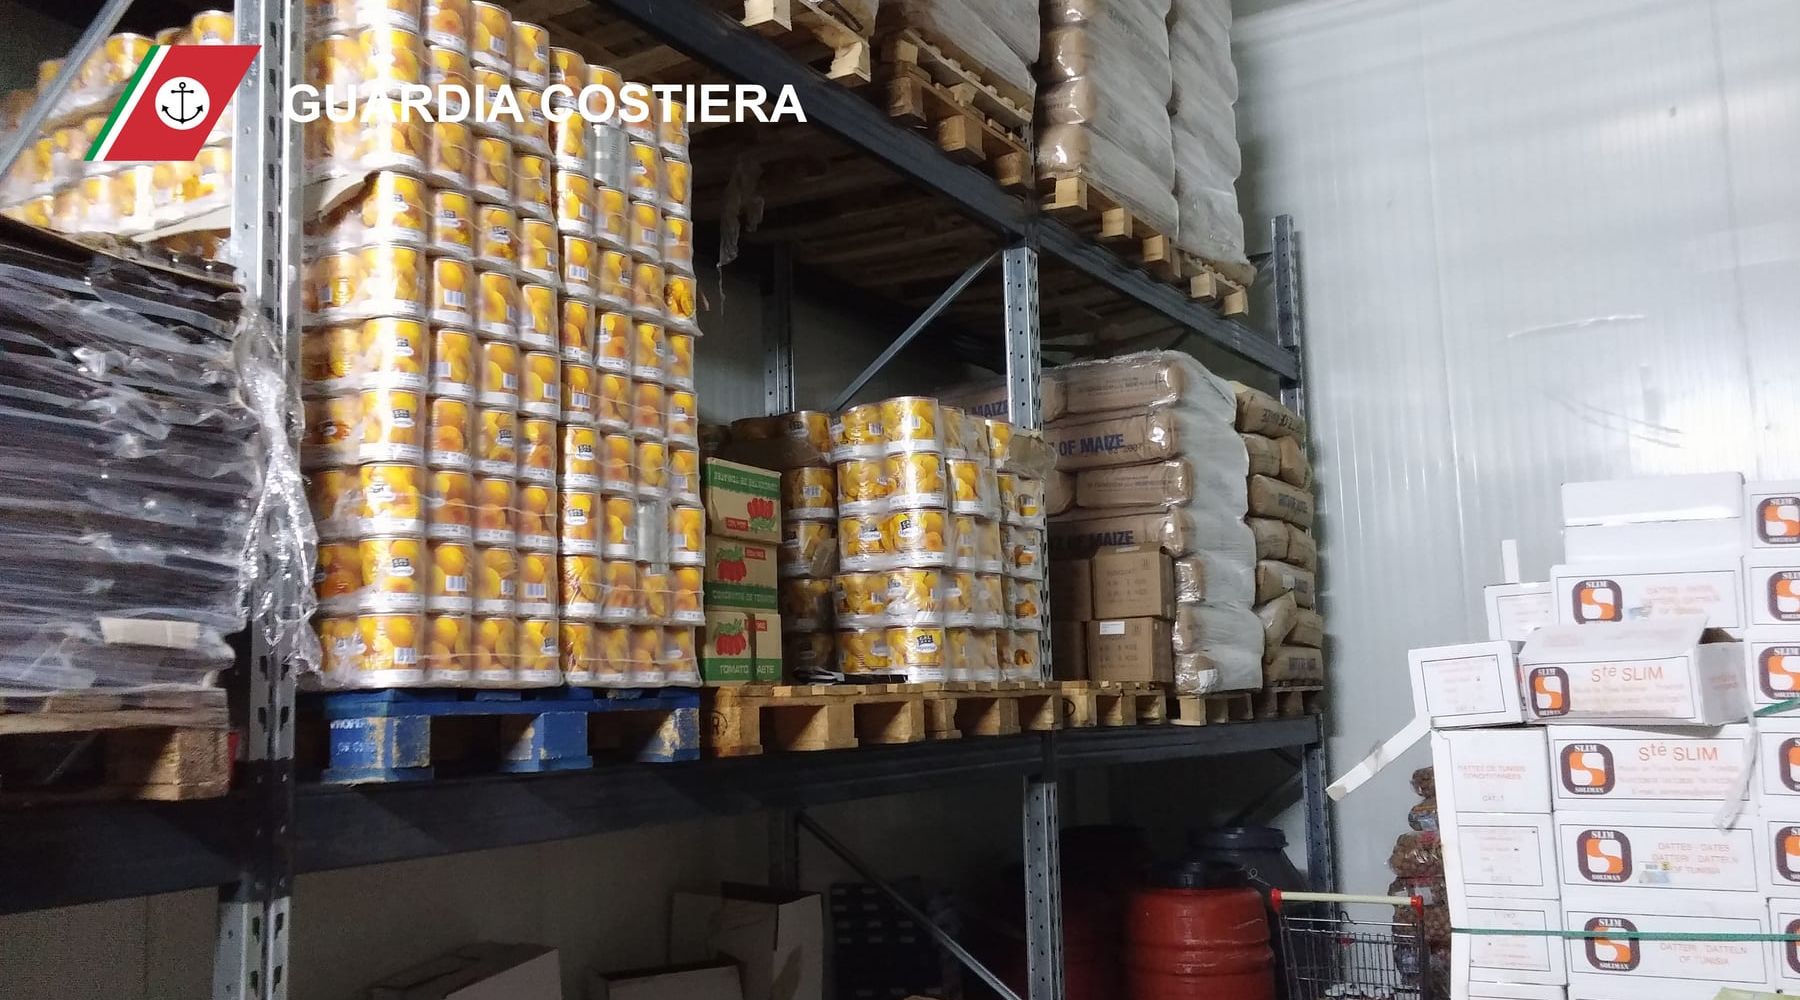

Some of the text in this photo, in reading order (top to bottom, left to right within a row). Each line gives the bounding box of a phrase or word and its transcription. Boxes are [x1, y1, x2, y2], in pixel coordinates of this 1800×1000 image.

[1059, 440, 1076, 456] OF
[1080, 433, 1125, 453] MAIZE
[1092, 530, 1135, 546] MAIZE
[1782, 572, 1800, 580] SLI
[1585, 580, 1608, 589] SLIM
[720, 664, 775, 675] TOMATO ASTE
[1622, 666, 1664, 682] SLIM
[1574, 744, 1598, 753] SLIM
[1673, 747, 1719, 761] SLIM
[1591, 830, 1615, 839] SLIM
[1599, 918, 1622, 928] SLIM
